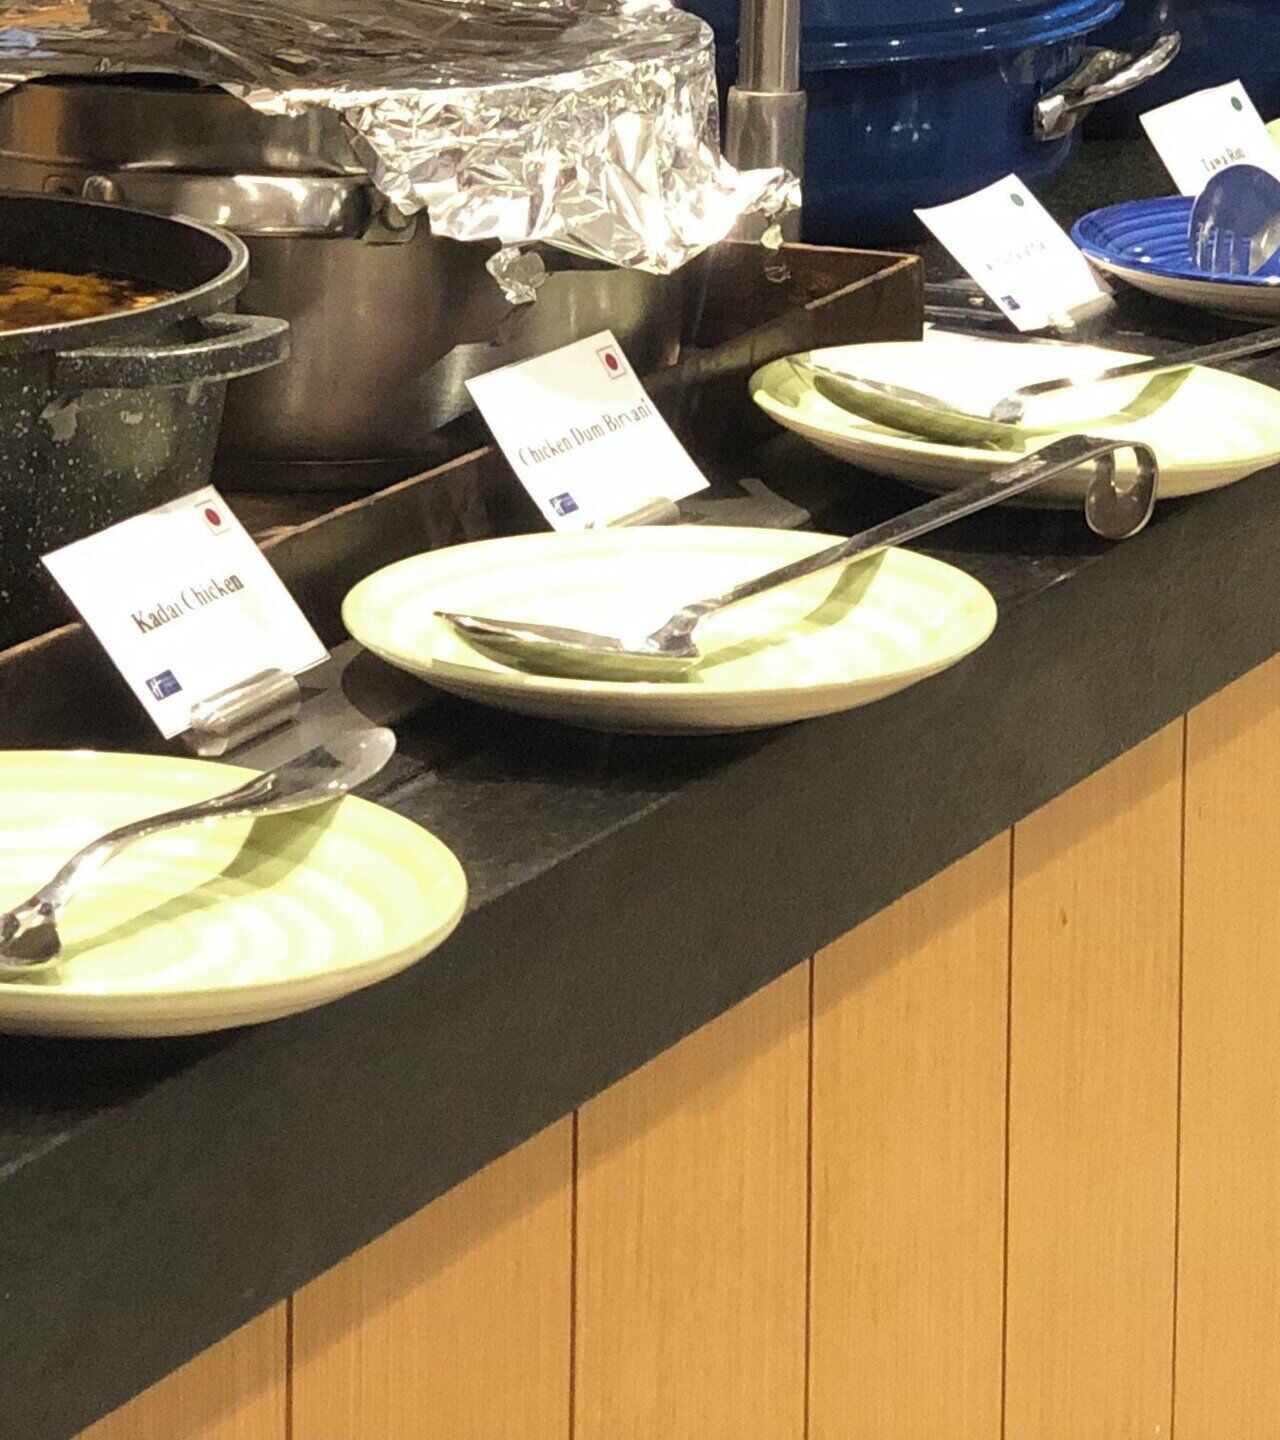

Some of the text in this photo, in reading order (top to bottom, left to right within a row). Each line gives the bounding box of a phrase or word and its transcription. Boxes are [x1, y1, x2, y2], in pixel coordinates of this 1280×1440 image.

[518, 437, 573, 466] Chicken
[570, 423, 605, 446] Dum
[130, 574, 245, 634] Kadai Chicken
